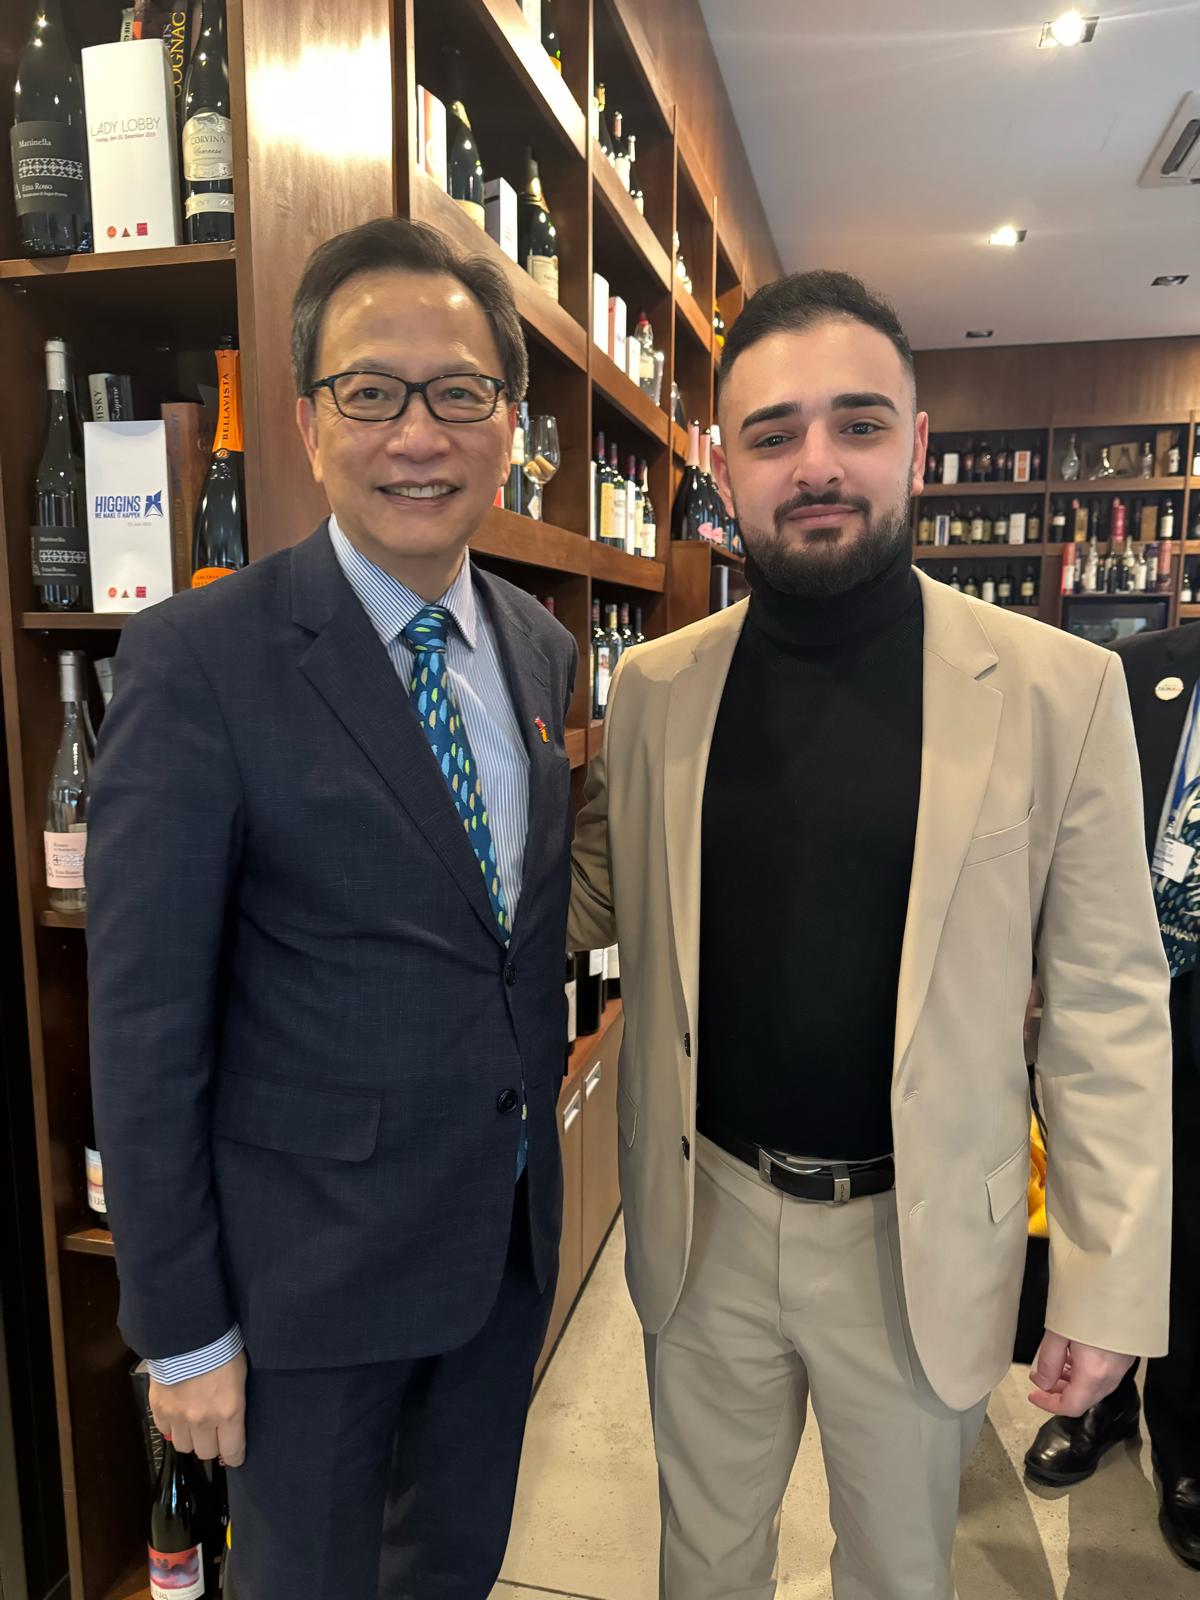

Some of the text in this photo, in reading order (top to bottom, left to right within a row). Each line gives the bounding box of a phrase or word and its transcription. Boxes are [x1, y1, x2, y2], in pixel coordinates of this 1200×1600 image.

[90, 116, 160, 137] LADY LOBBY
[190, 135, 226, 145] CORVINA
[94, 390, 105, 419] ISKY
[222, 373, 231, 441] BELLAVISTA
[95, 495, 141, 513] HIGGINS
[1160, 923, 1199, 942] AIWAN
